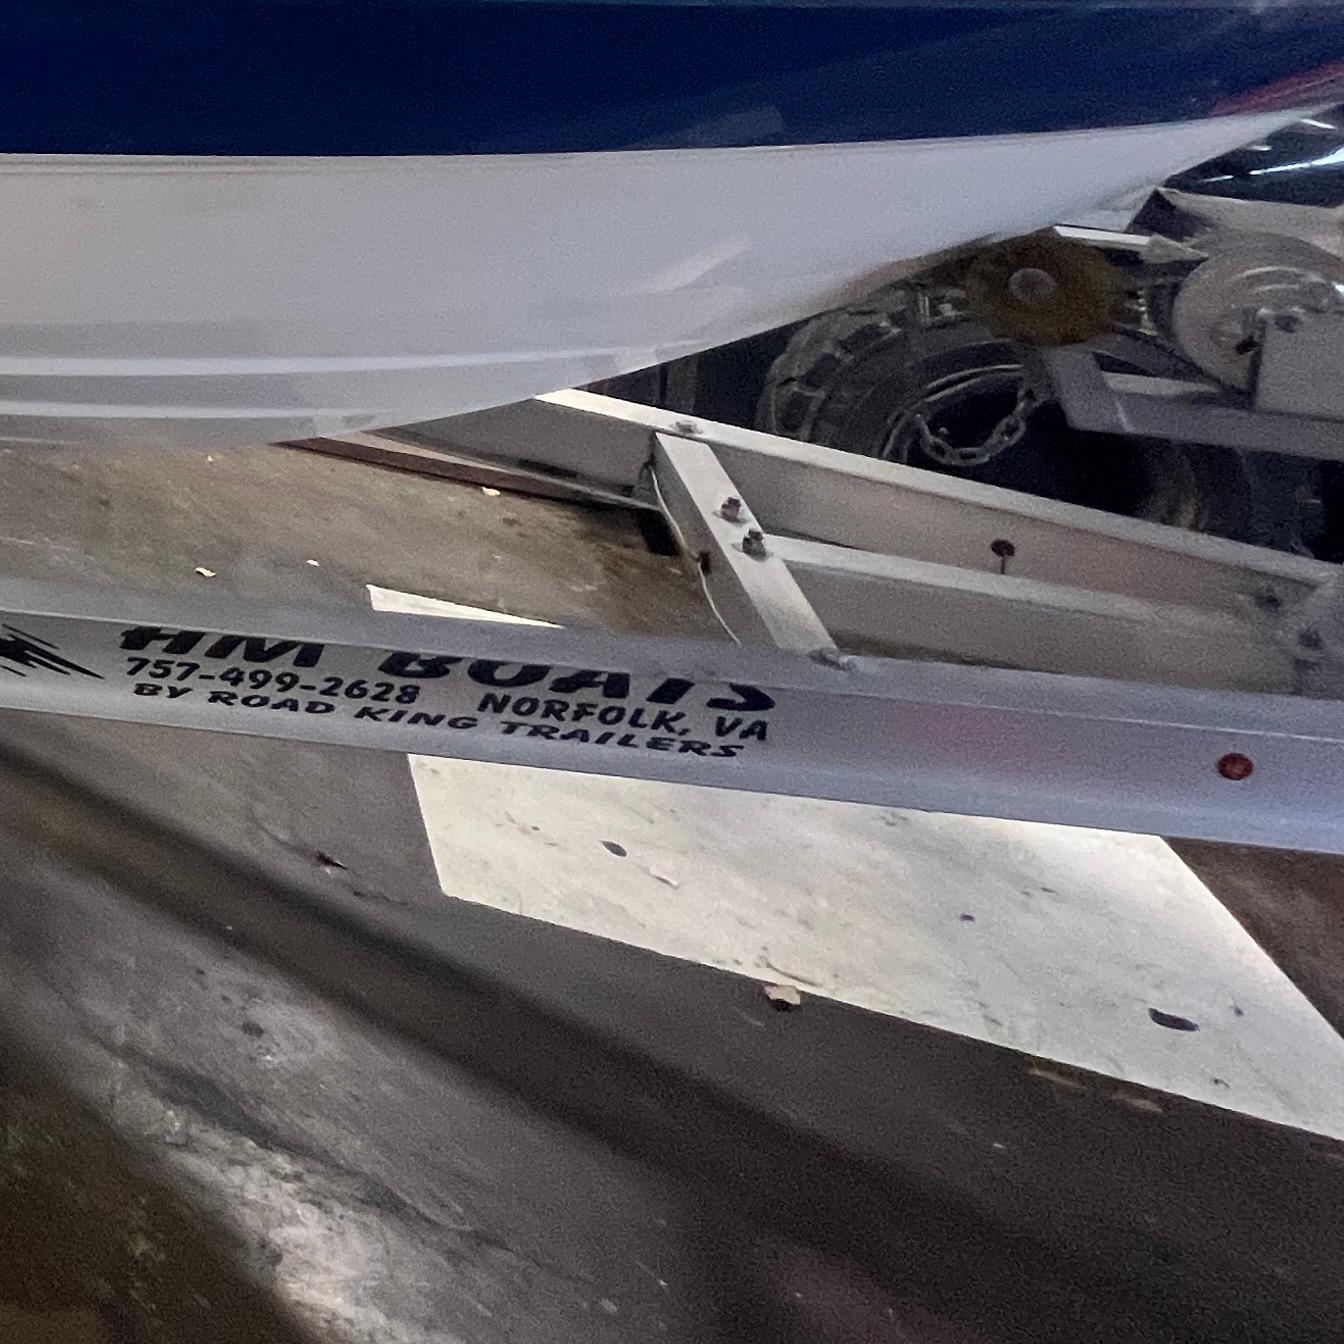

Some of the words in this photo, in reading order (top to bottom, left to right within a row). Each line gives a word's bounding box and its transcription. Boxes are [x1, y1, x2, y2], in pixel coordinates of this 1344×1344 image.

[126, 656, 421, 705] 757-499-2628
[477, 673, 687, 737] NORFOLK,
[714, 716, 768, 741] VA
[133, 682, 193, 699] BY
[208, 691, 337, 714] ROAD
[354, 706, 478, 731] KING
[500, 721, 744, 758] TRAILERS
